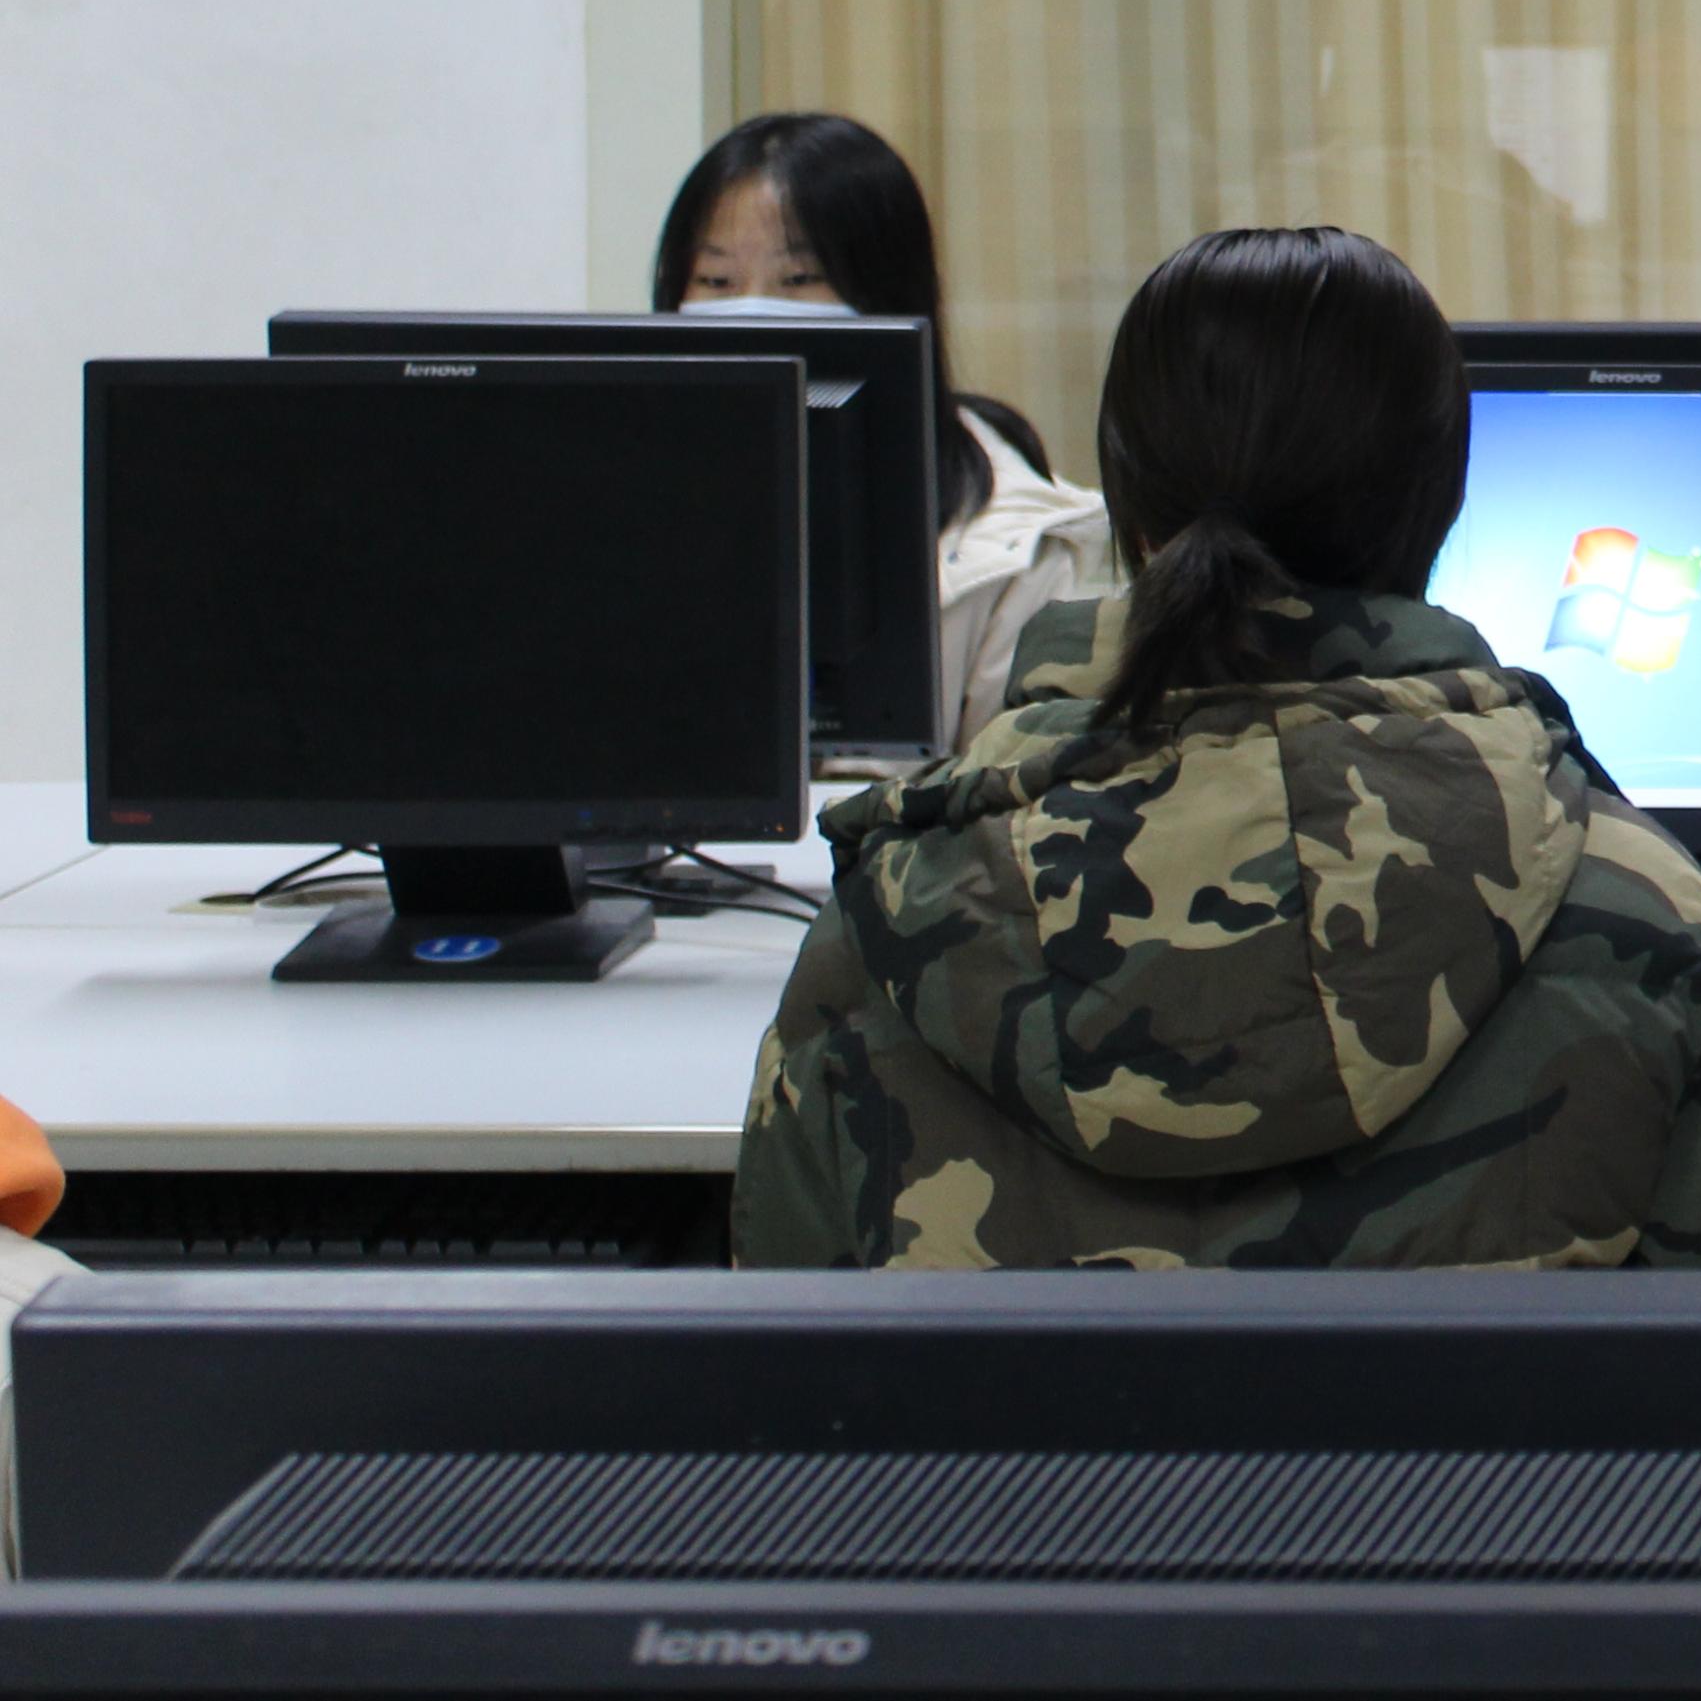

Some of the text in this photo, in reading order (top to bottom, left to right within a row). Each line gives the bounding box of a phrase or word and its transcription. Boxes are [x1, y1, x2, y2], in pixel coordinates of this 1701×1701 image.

[403, 362, 477, 377] lenovo
[1588, 369, 1662, 384] lenovo
[632, 1618, 871, 1666] lenovo
